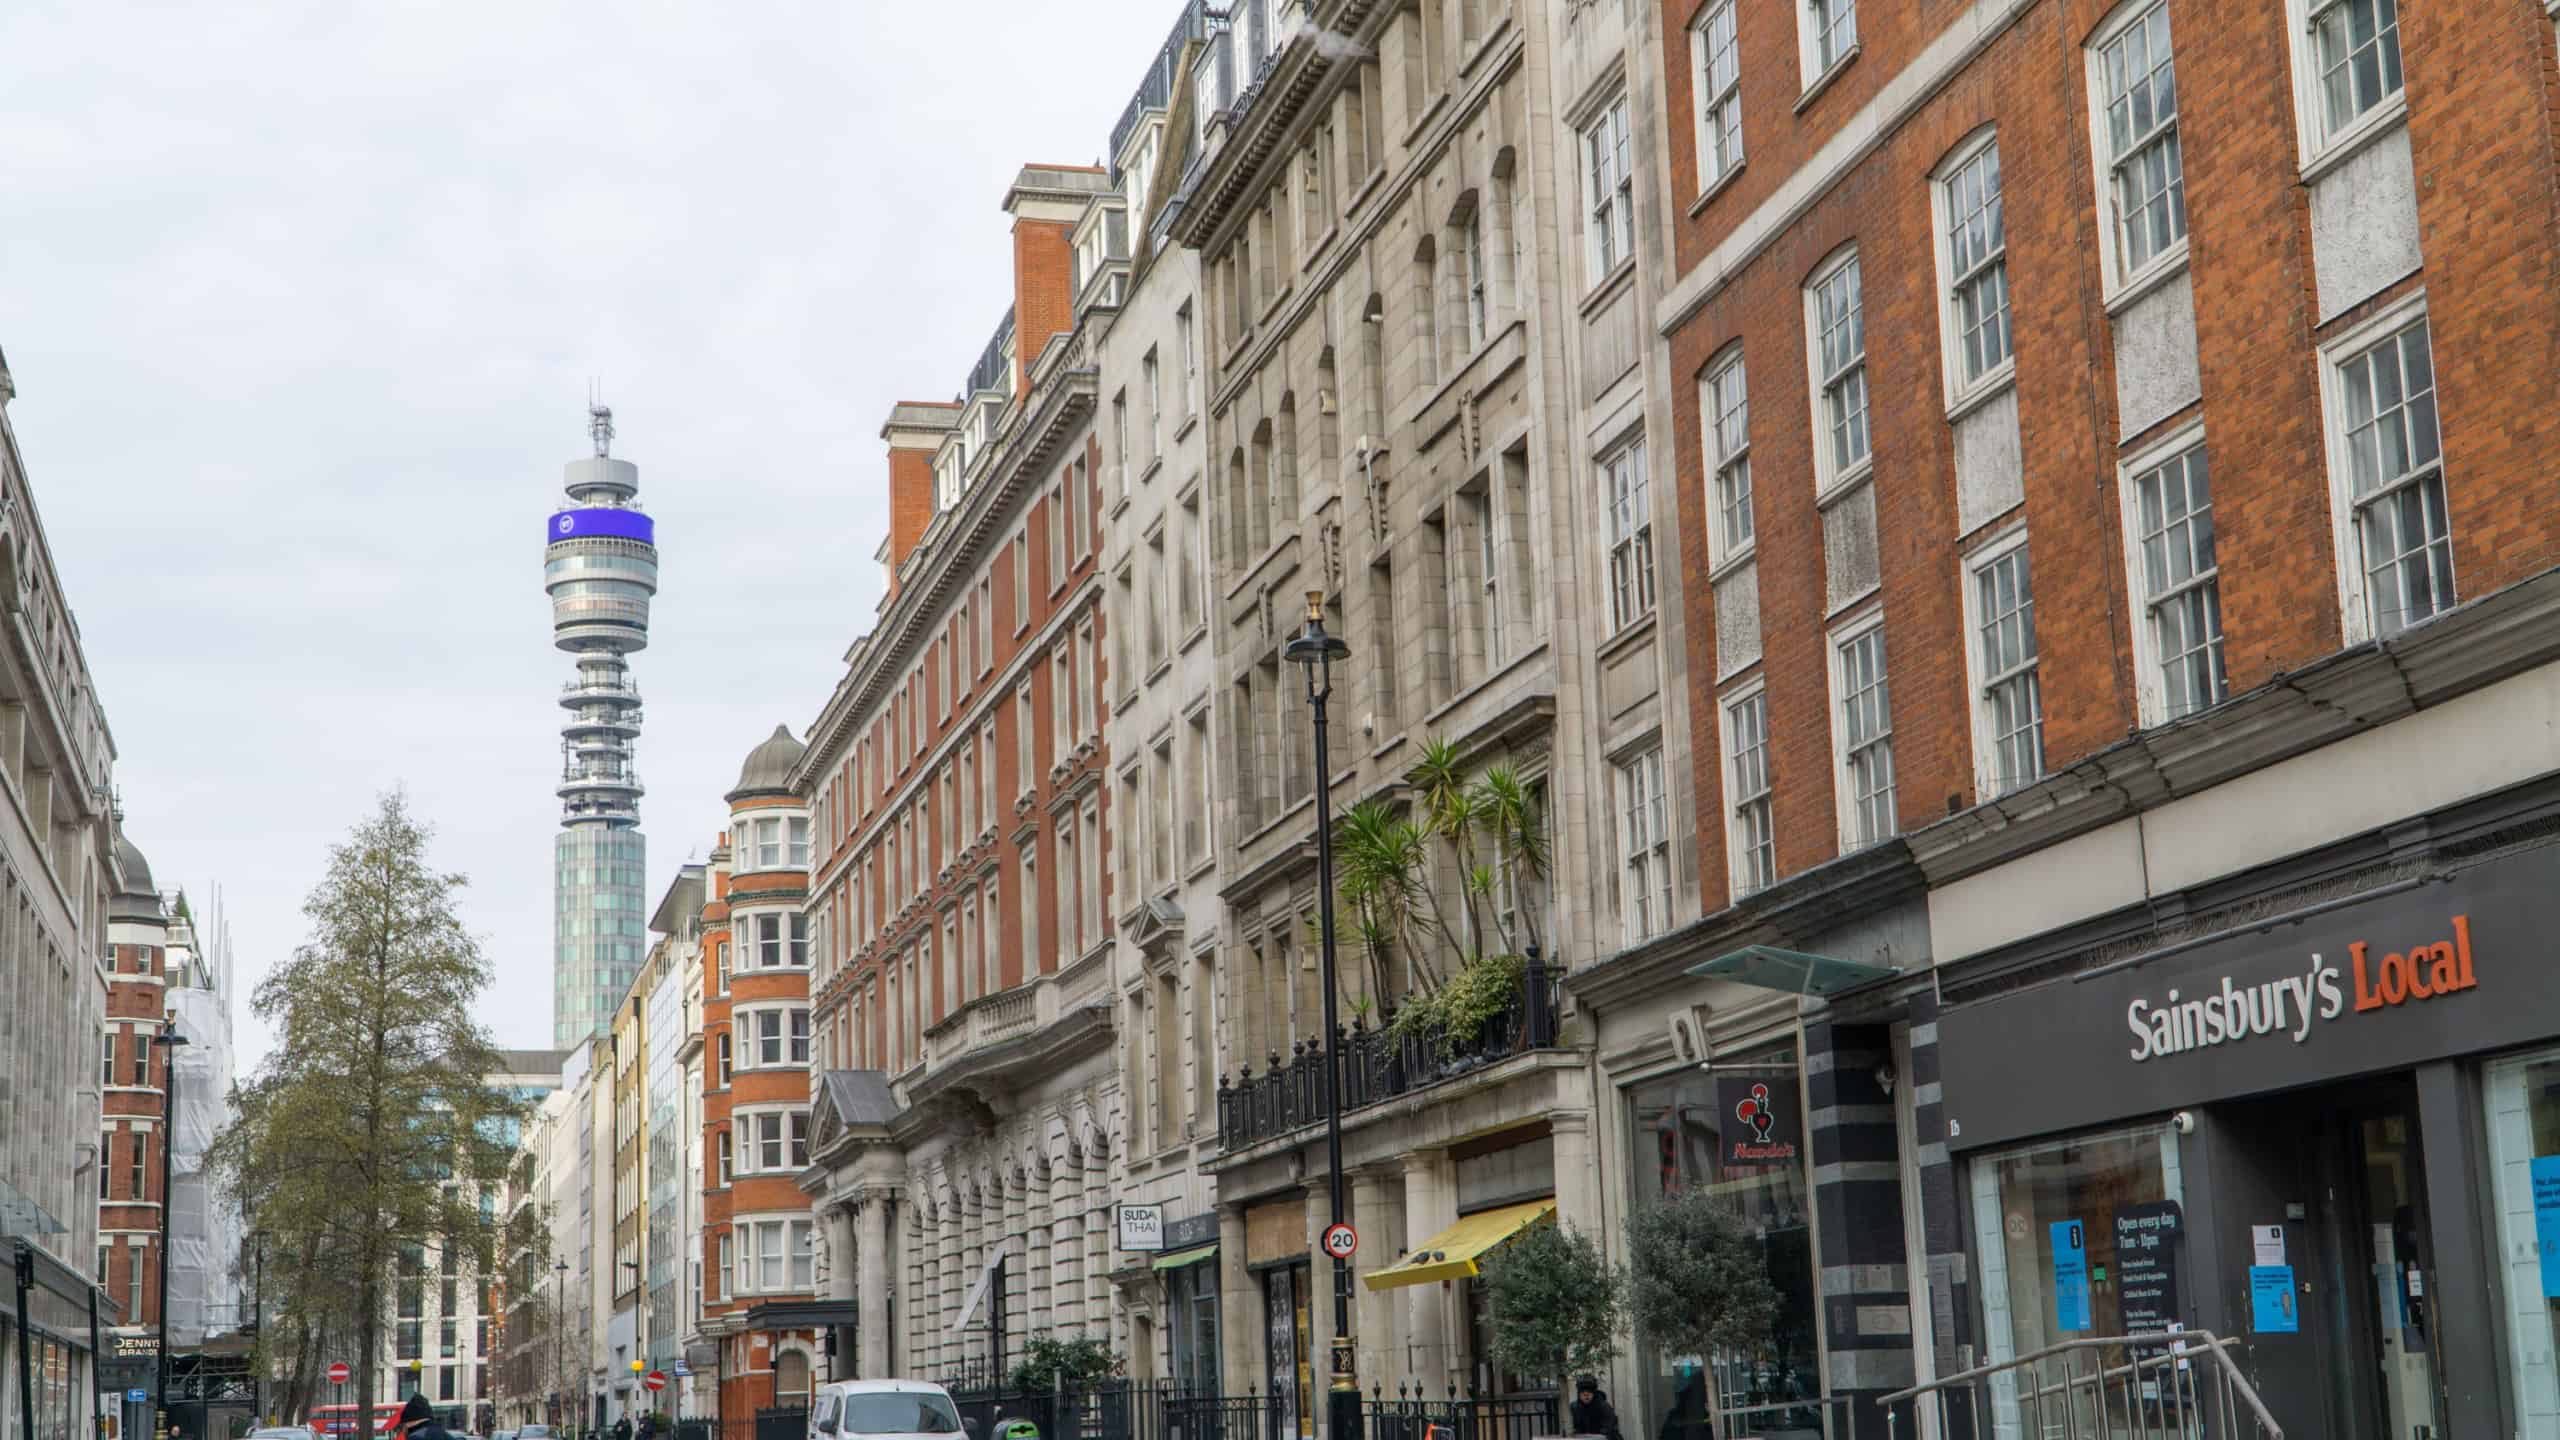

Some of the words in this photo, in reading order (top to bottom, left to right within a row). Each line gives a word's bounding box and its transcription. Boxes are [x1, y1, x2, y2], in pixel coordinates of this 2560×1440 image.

[2127, 953, 2344, 1062] Sainsbury's
[2348, 912, 2477, 1013] Local
[1124, 1210, 1157, 1221] SUDA
[1126, 1222, 1156, 1233] THAI
[2118, 1217, 2138, 1233] Open
[1332, 1234, 1354, 1247] 20
